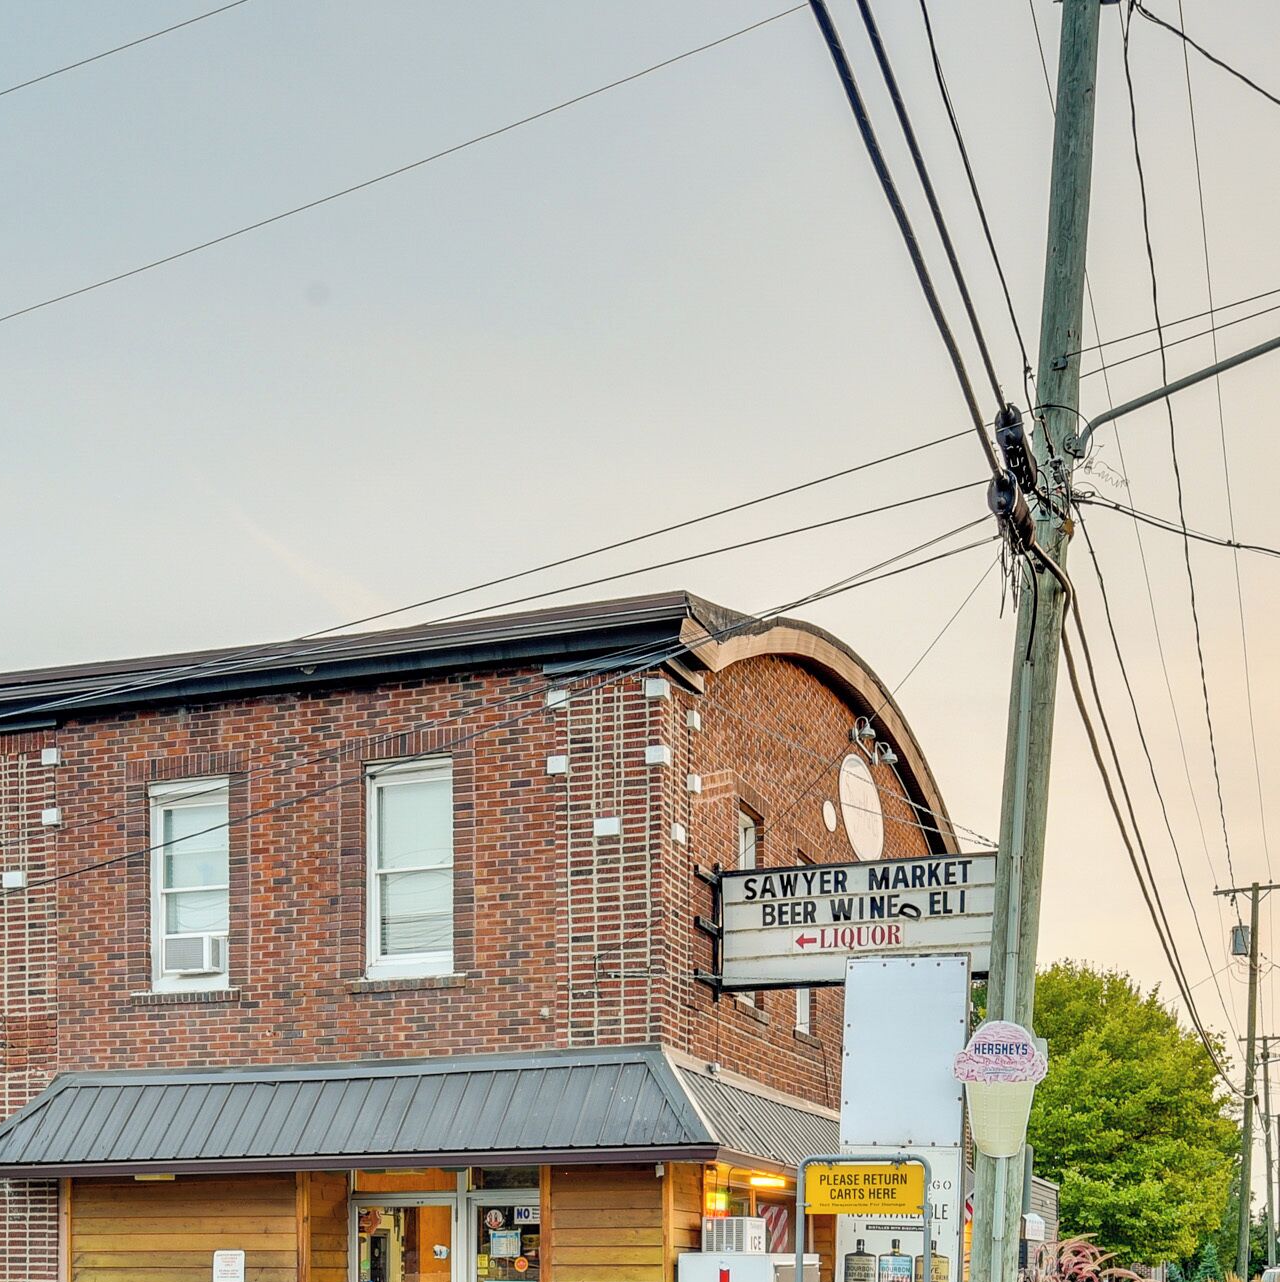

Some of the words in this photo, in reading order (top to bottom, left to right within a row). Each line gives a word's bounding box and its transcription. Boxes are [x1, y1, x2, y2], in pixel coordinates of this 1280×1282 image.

[744, 870, 848, 900] SAWYER
[869, 860, 972, 891] MARKET
[762, 900, 817, 927] BEER
[830, 894, 900, 922] WINE
[820, 924, 901, 950] LIQUOR
[819, 1174, 860, 1186] PLEASE
[863, 1173, 907, 1185] RETURN
[830, 1188, 865, 1200] CARTS
[869, 1188, 897, 1199] HERE
[516, 1207, 530, 1219] NO
[750, 1235, 762, 1251] ICE
